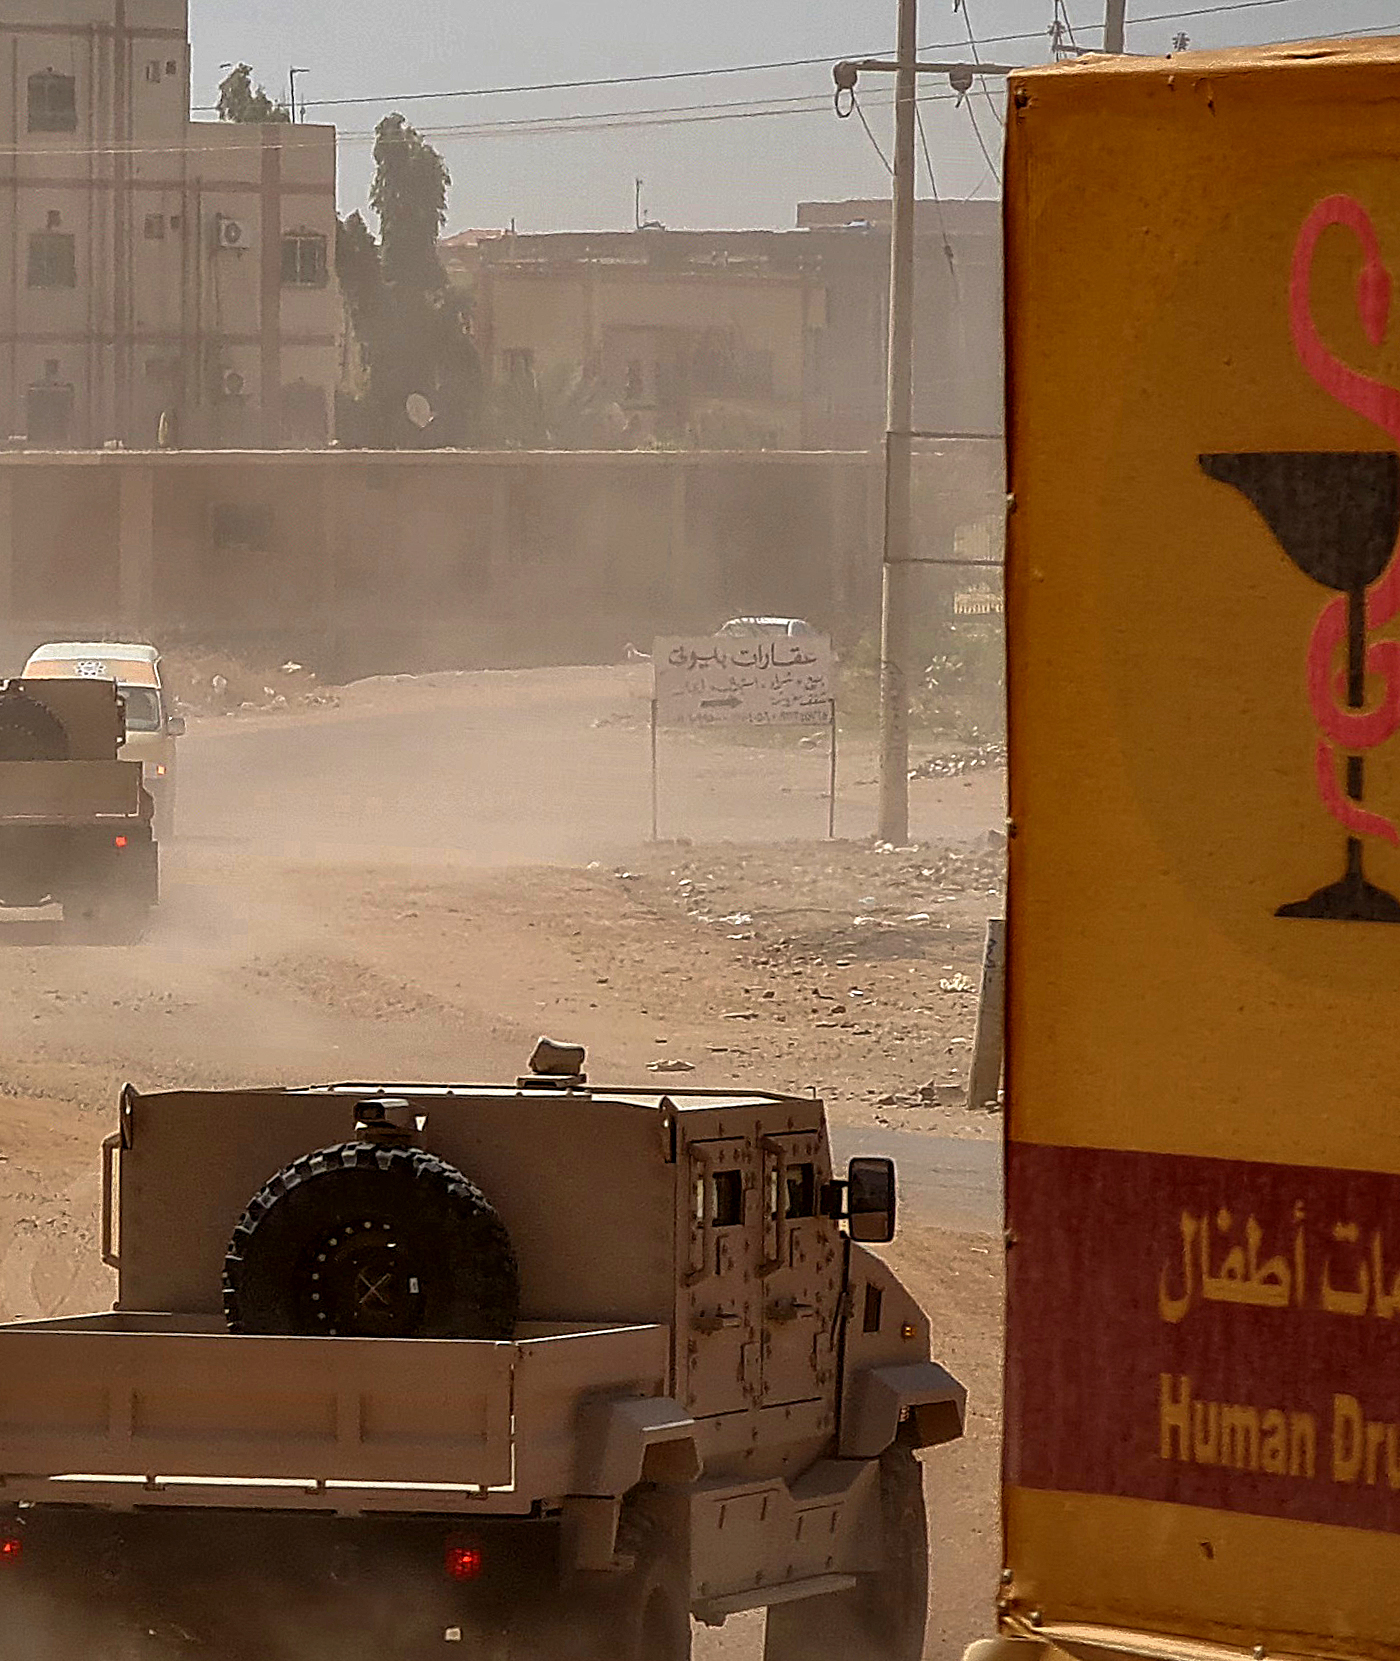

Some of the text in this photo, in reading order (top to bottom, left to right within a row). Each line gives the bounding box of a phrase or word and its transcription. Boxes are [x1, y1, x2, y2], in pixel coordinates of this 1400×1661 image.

[731, 642, 817, 669] عقارات
[1158, 1201, 1307, 1324] أطفال
[1160, 1372, 1317, 1479] Human
